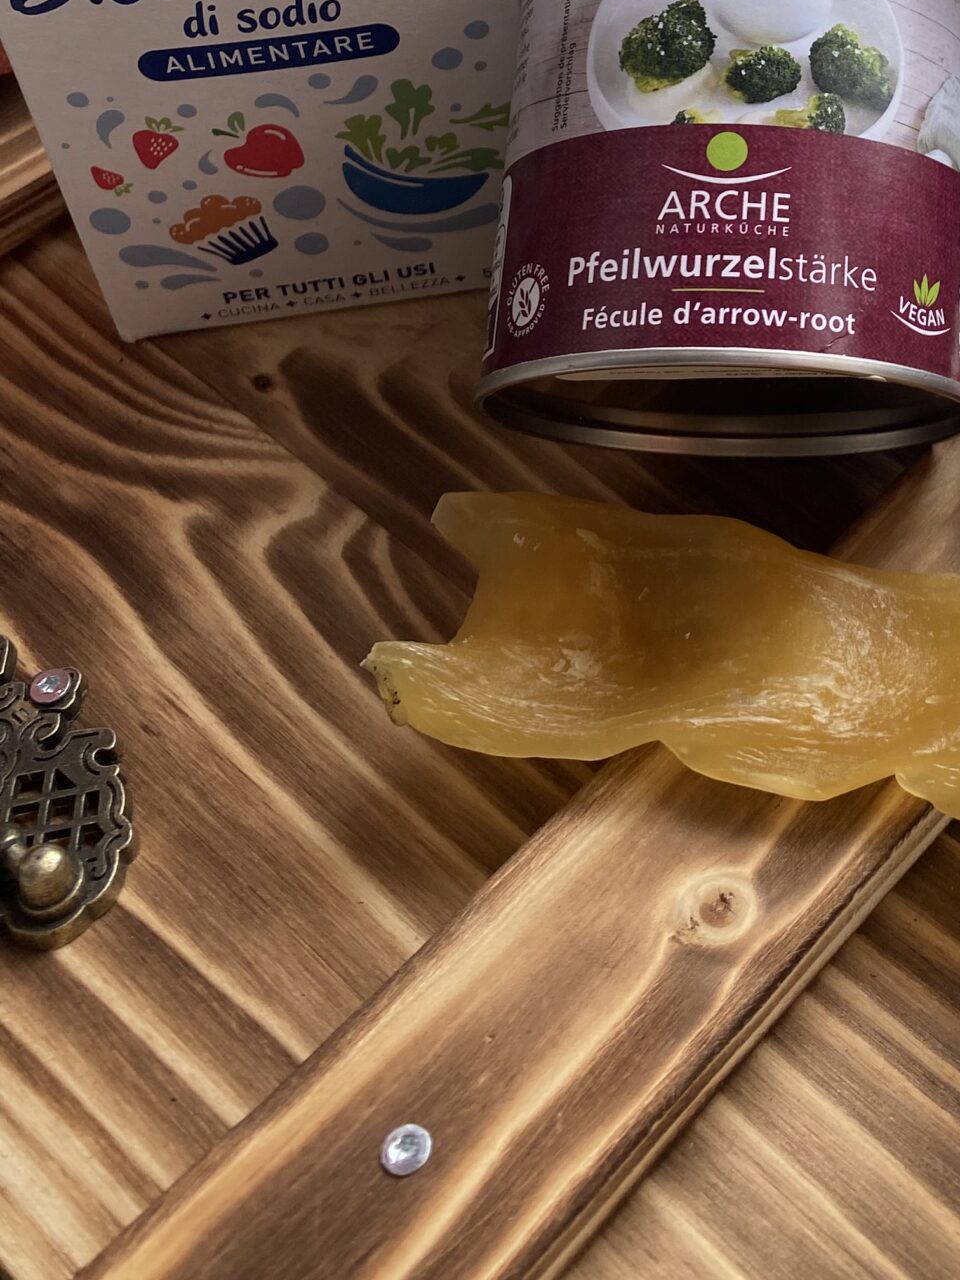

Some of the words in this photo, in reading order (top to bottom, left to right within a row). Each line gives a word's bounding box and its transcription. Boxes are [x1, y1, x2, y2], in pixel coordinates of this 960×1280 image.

[183, 0, 220, 38] di
[165, 31, 376, 75] ALIMENTARE
[551, 71, 566, 133] Suggestion
[560, 41, 577, 129] Serviervorschlag
[658, 190, 792, 224] ARCHE
[656, 221, 790, 238] NATURKÜCHE
[222, 287, 272, 305] PER
[276, 276, 346, 298] TUTTI
[352, 269, 390, 287] GLI
[396, 261, 436, 280] USI
[506, 263, 534, 307] GLUTEN
[533, 263, 551, 293] FREE
[566, 248, 878, 292] Pfeilwurzelstärke
[217, 302, 281, 320] CUCINA
[303, 293, 346, 307] CASA
[368, 276, 451, 297] BELLEZZA
[581, 301, 662, 331] Fécule
[899, 295, 946, 329] VEGAN
